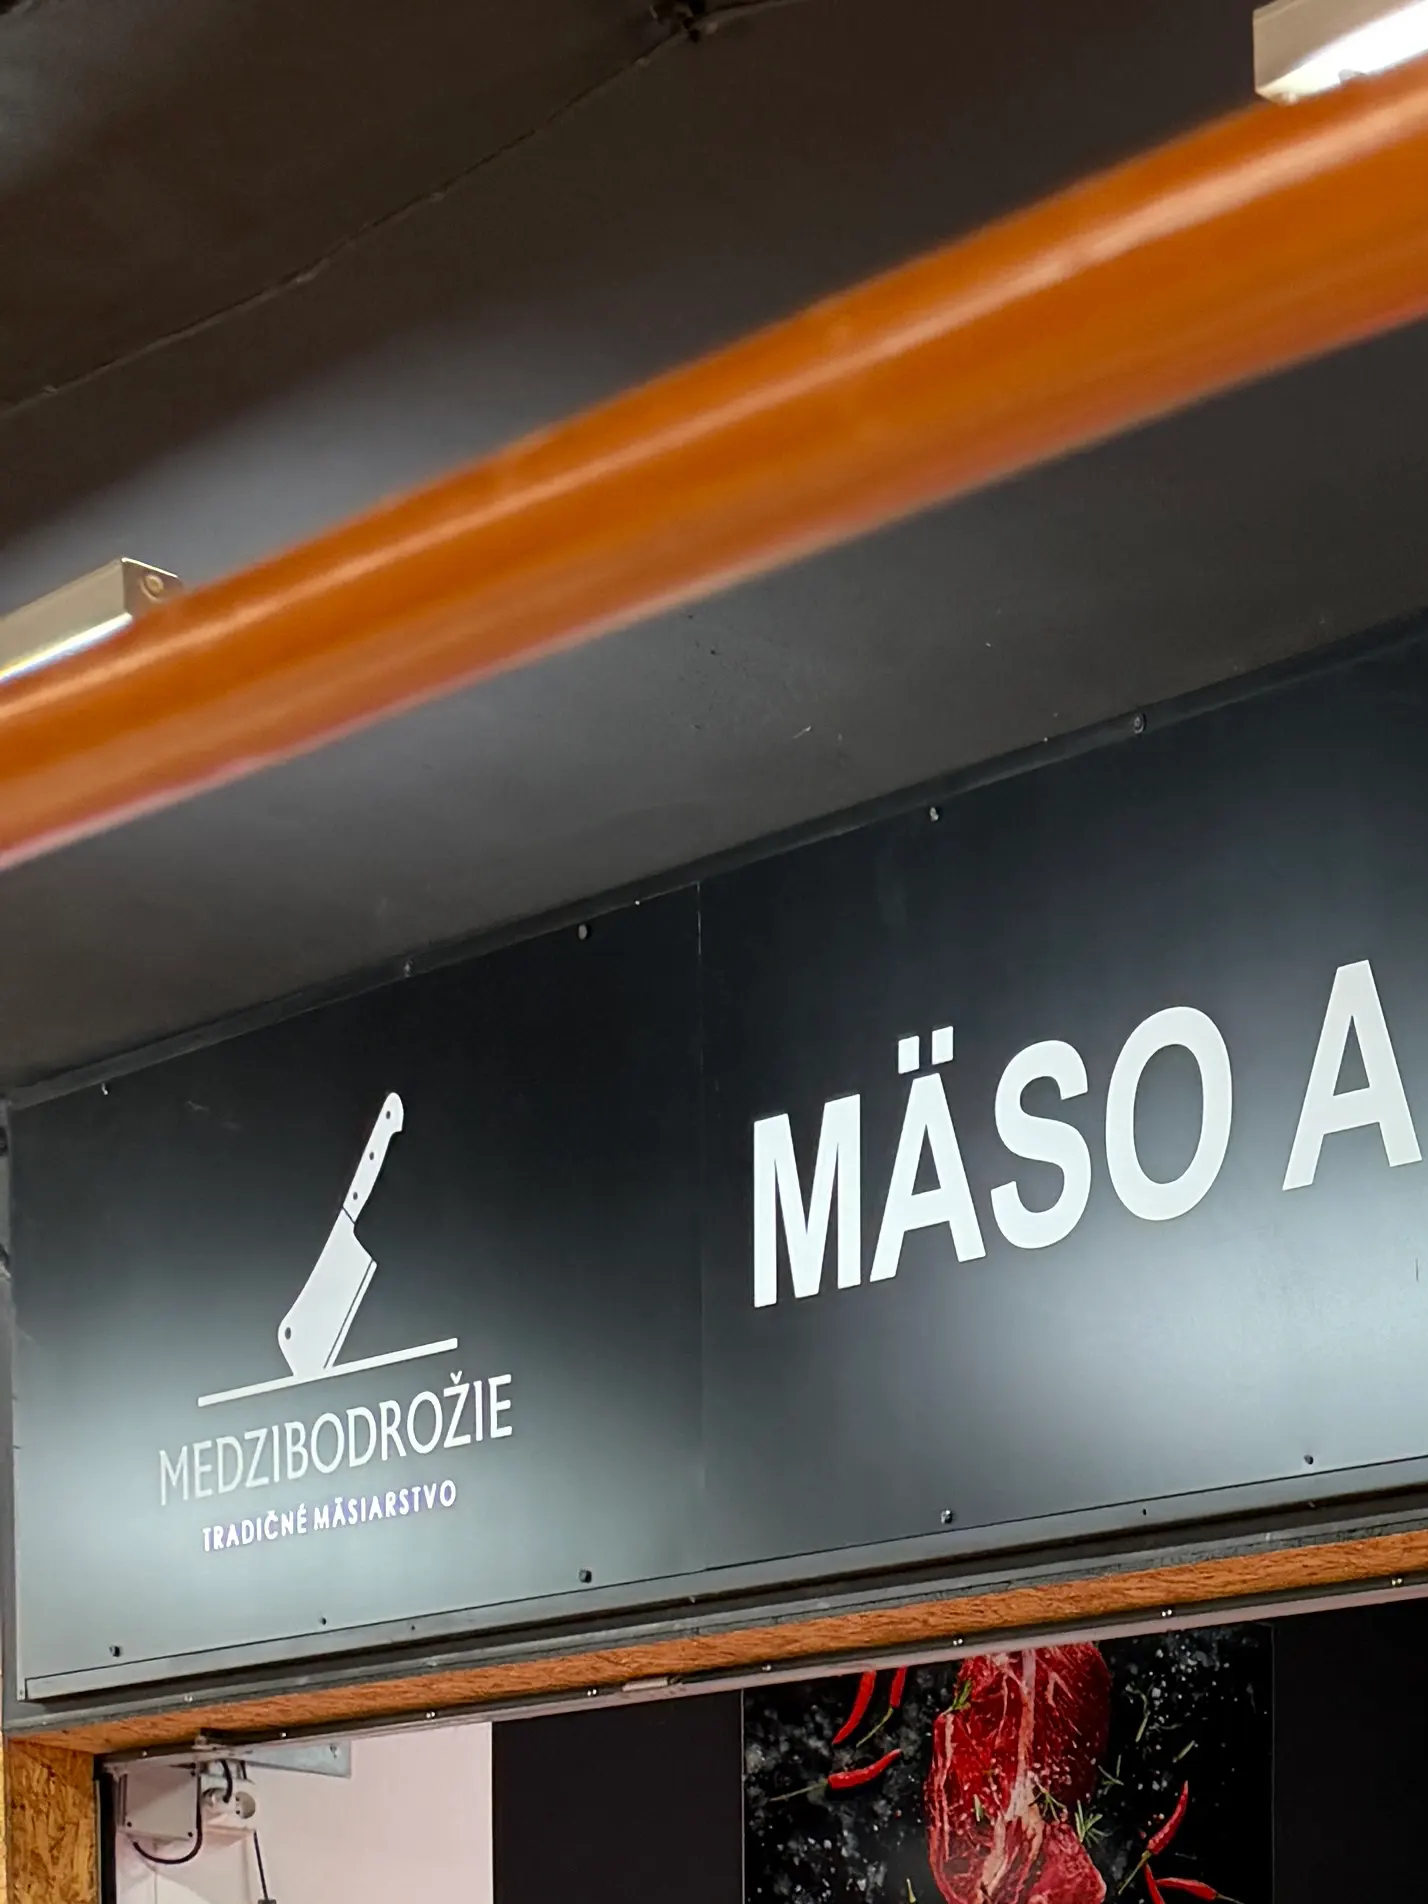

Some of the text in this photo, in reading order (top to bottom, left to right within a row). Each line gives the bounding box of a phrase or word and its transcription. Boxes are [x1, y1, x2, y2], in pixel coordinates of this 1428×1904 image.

[753, 1005, 1235, 1309] MÄSO
[1281, 960, 1424, 1191] A
[159, 1370, 513, 1506] MEDZIBODROŽIE
[203, 1479, 457, 1551] TRADIČNÉ MÄSIARSTVO
